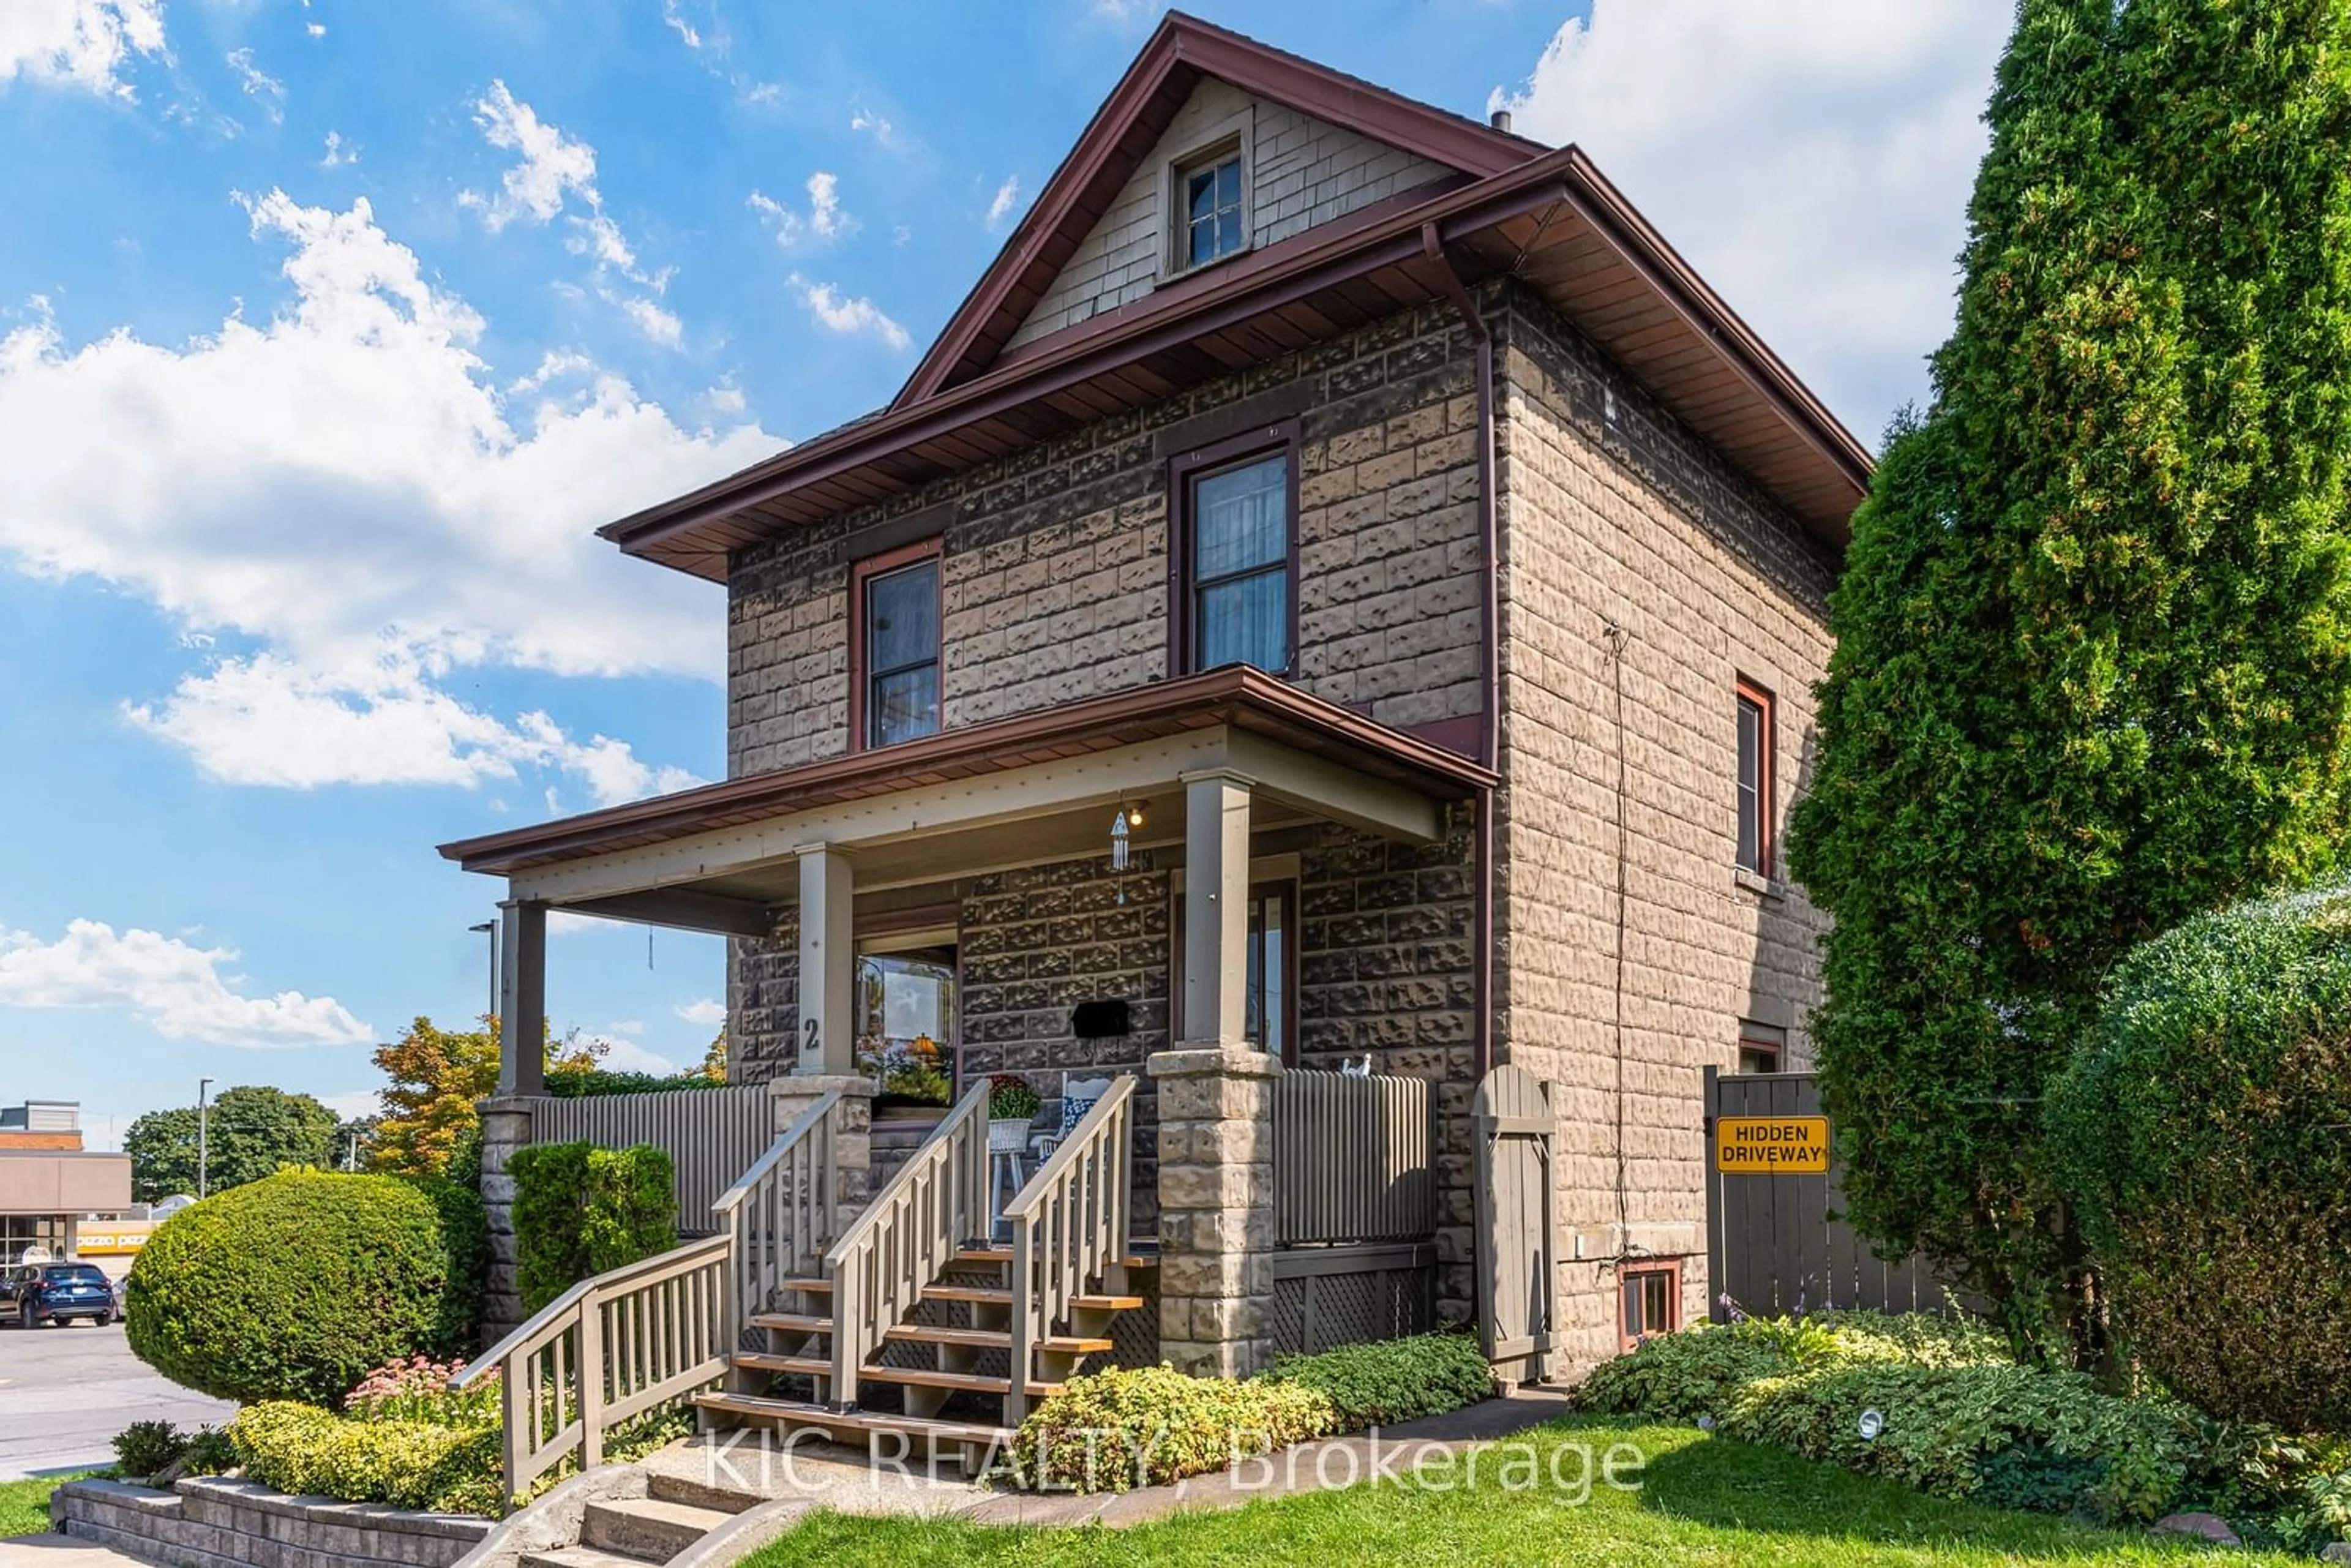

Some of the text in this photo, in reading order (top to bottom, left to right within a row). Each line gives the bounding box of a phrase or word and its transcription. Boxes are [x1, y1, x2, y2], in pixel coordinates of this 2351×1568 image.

[804, 1019, 819, 1050] 2
[1736, 1126, 1809, 1142] HIDDEN
[1722, 1146, 1822, 1162] DRIVEWAY
